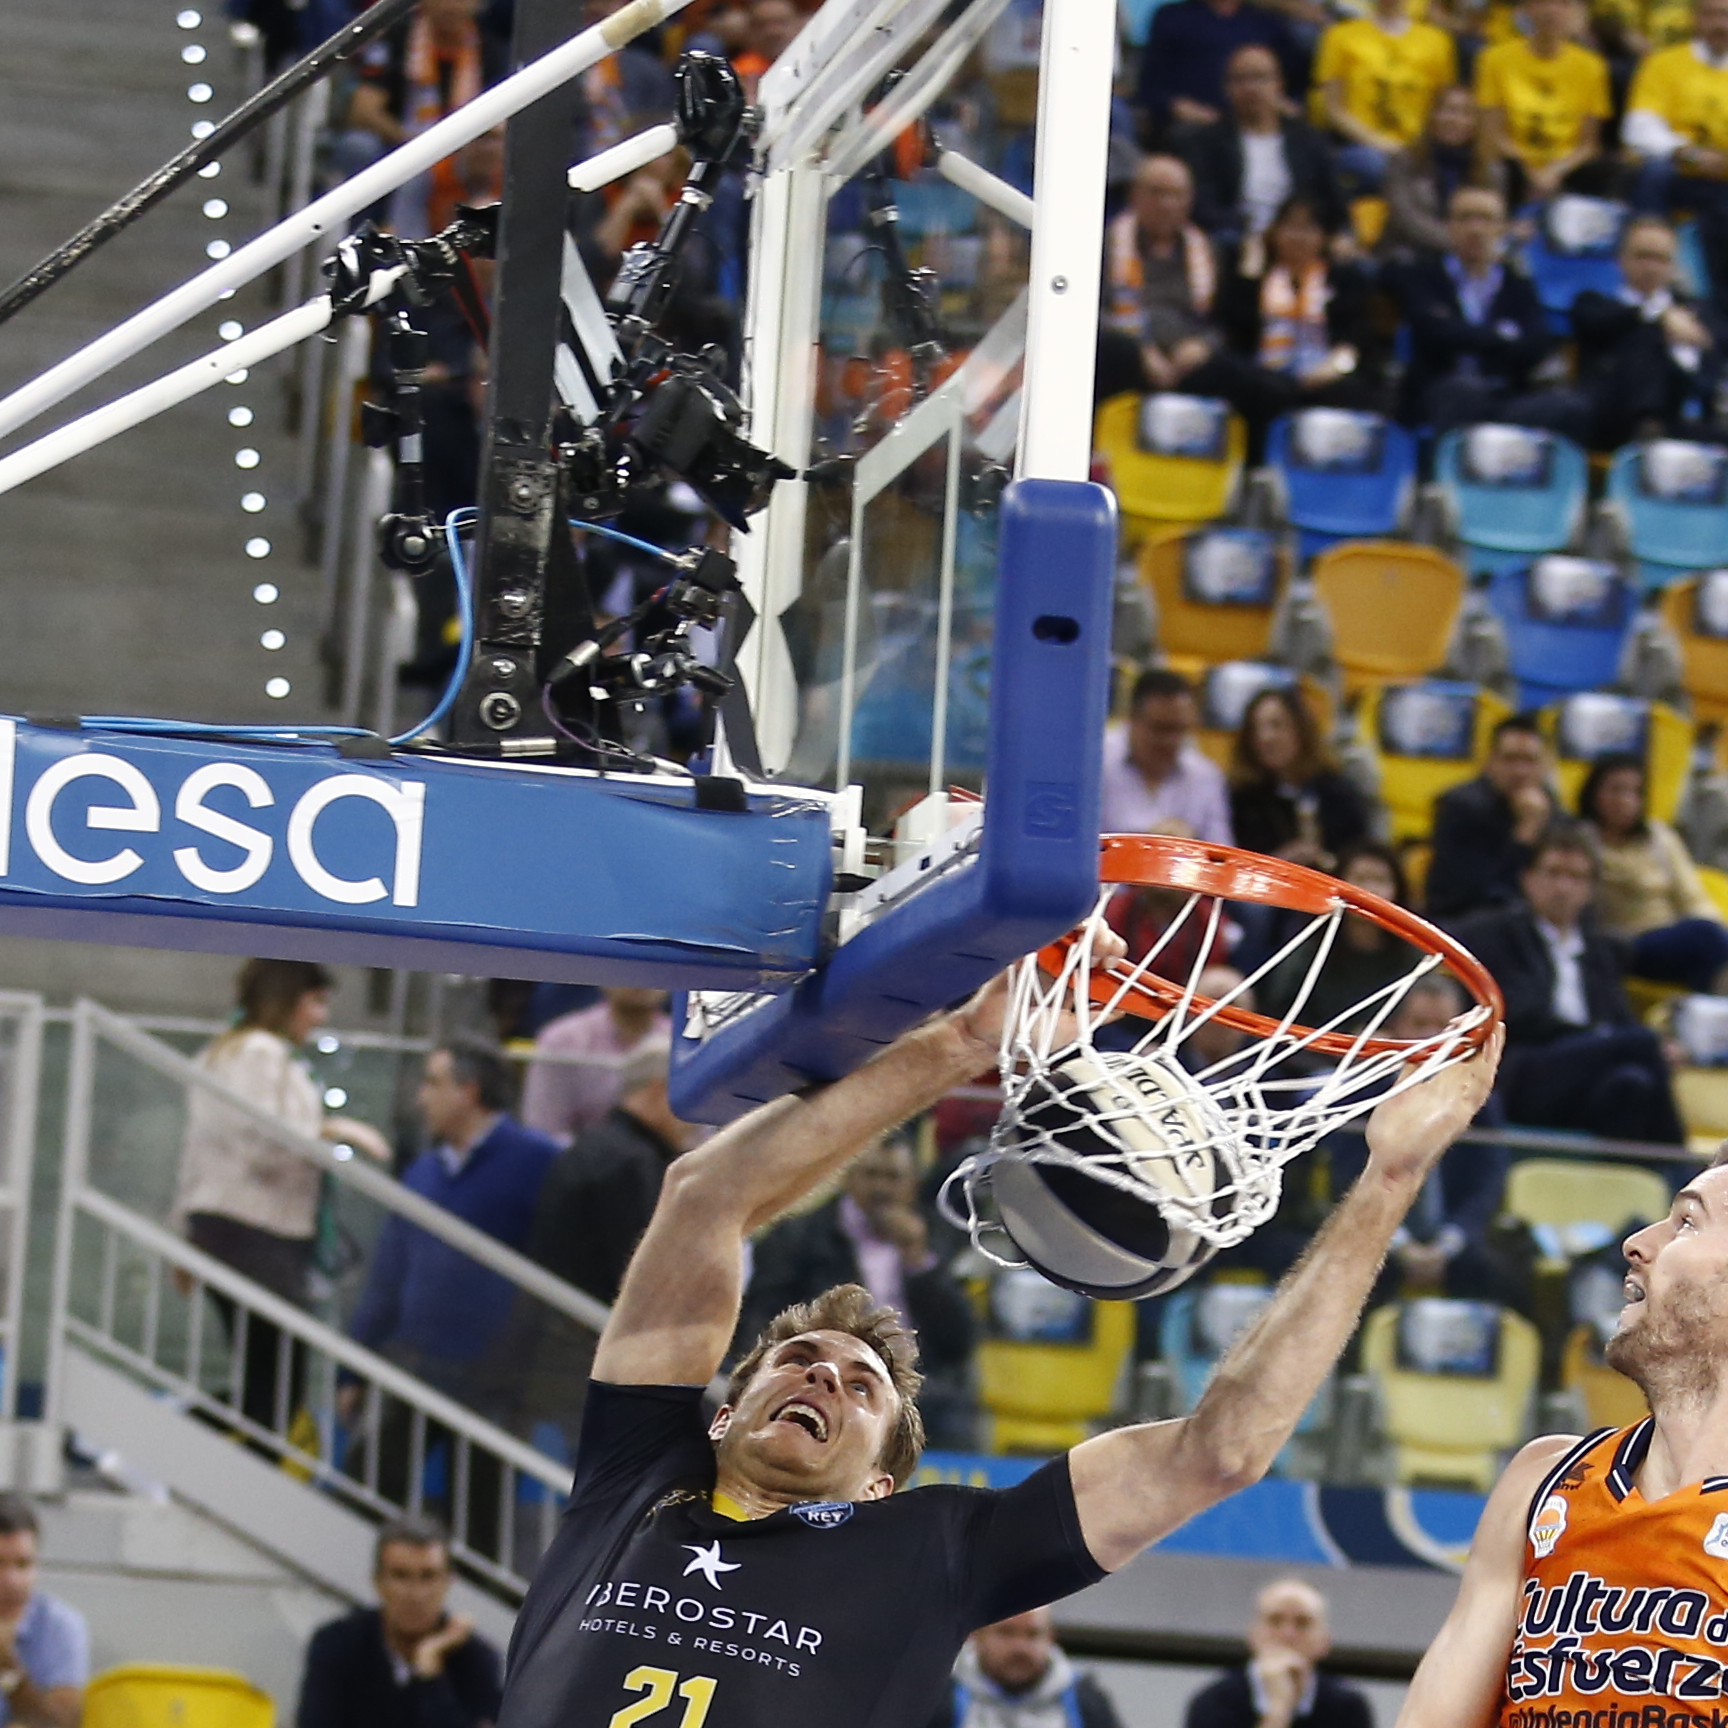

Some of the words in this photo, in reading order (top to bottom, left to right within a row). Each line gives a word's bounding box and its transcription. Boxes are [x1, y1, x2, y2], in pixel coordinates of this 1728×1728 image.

[577, 1618, 657, 1641] HOTELS
[666, 1631, 683, 1646] &
[693, 1636, 802, 1678] RESORTS
[584, 1581, 825, 1656] IBEROSTAR
